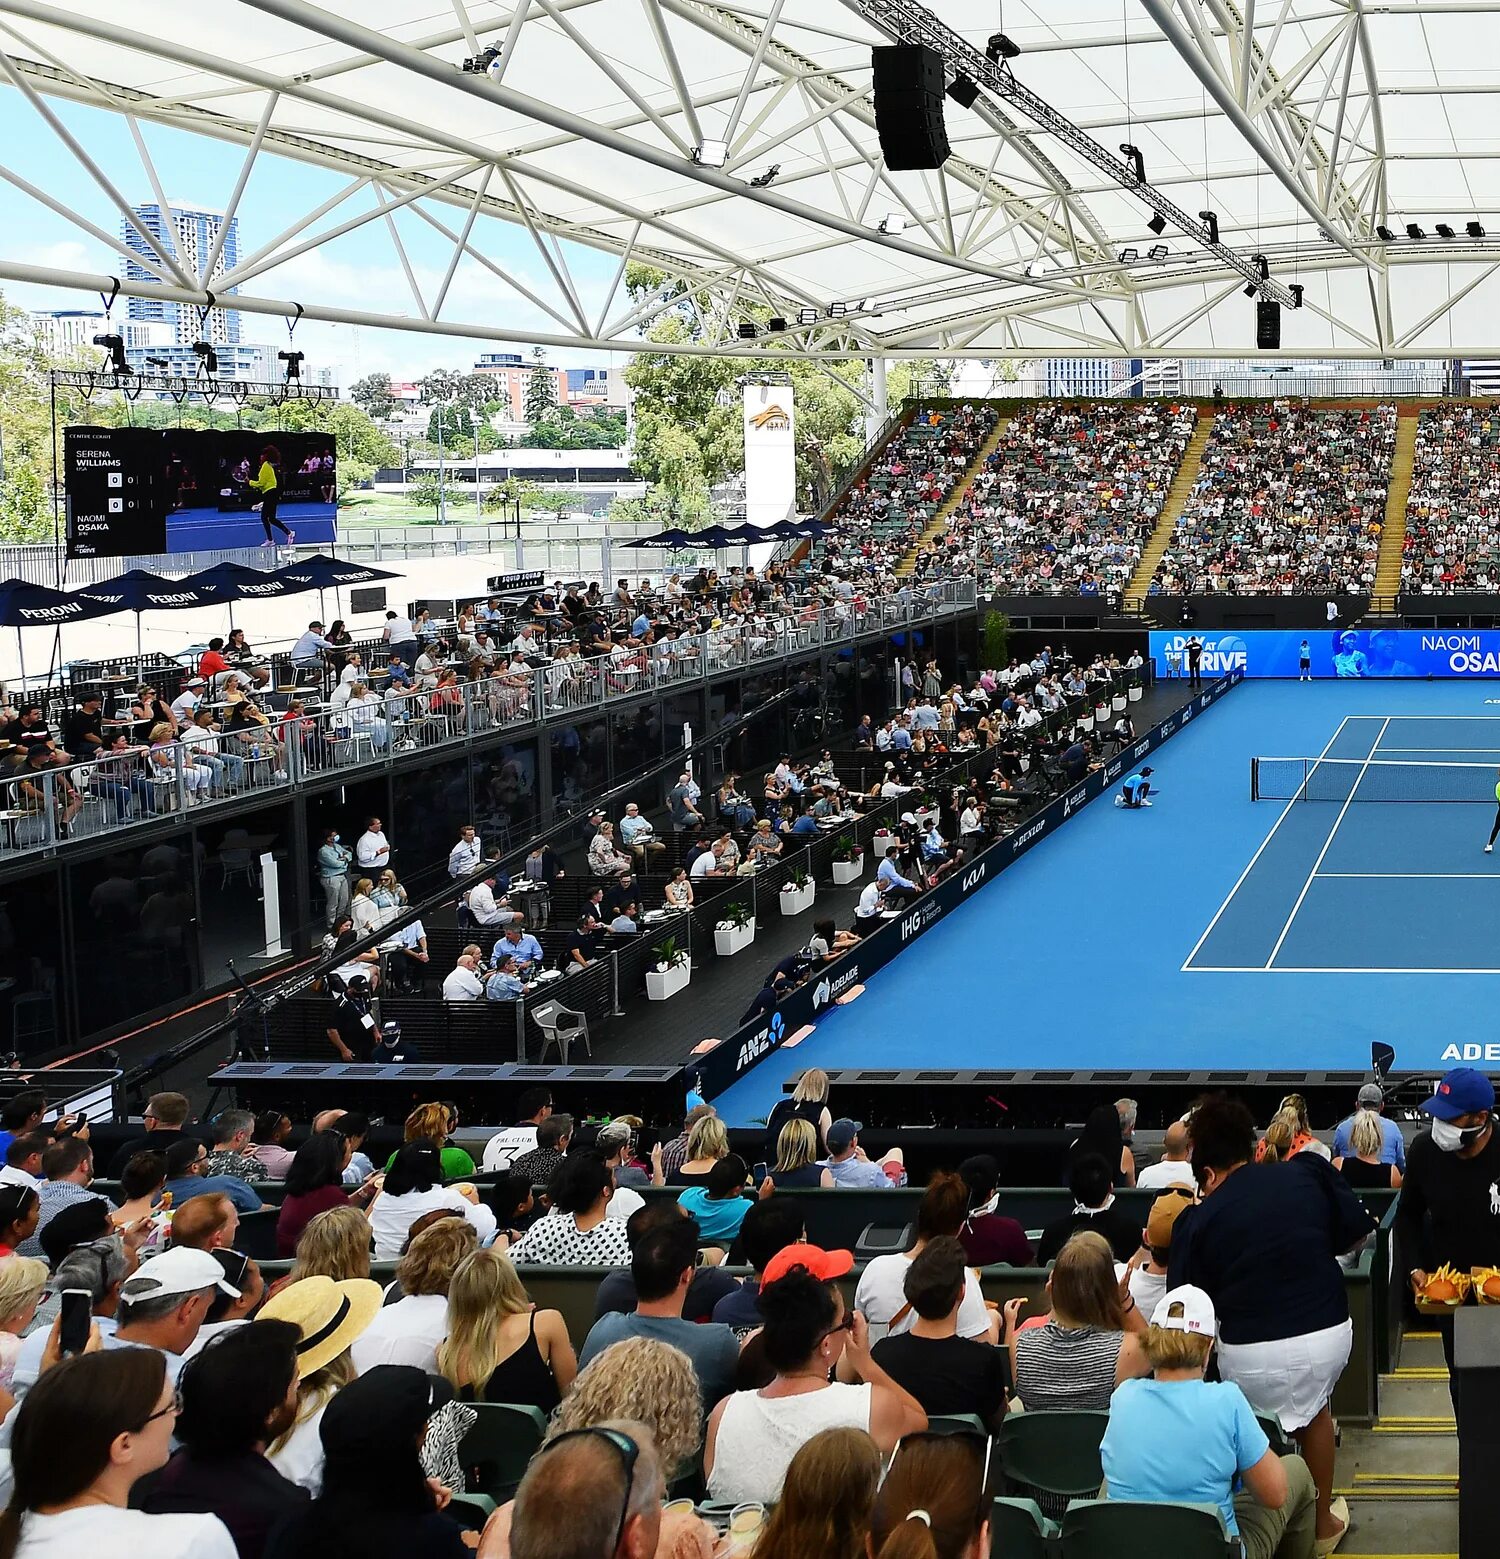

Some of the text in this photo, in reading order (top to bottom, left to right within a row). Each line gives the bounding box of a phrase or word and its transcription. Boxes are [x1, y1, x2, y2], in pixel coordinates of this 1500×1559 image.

[76, 450, 112, 458] SERENA
[76, 459, 121, 467] WILLIAMS
[112, 476, 134, 484] 0 0
[112, 500, 135, 509] 0 0
[77, 514, 106, 523] NAOMI
[77, 523, 109, 532] OSAKA
[332, 570, 375, 582] PERONI
[237, 580, 286, 593] PERONI
[147, 591, 200, 604] PERONI
[19, 601, 83, 620] PERONI
[1164, 642, 1173, 651] A
[1205, 642, 1217, 651] AT
[1421, 635, 1480, 651] NAOMI
[1018, 819, 1046, 847] DUNLOP
[901, 911, 921, 941] IHG
[830, 965, 859, 994] ADELAIDE
[736, 1027, 770, 1072] ANZ
